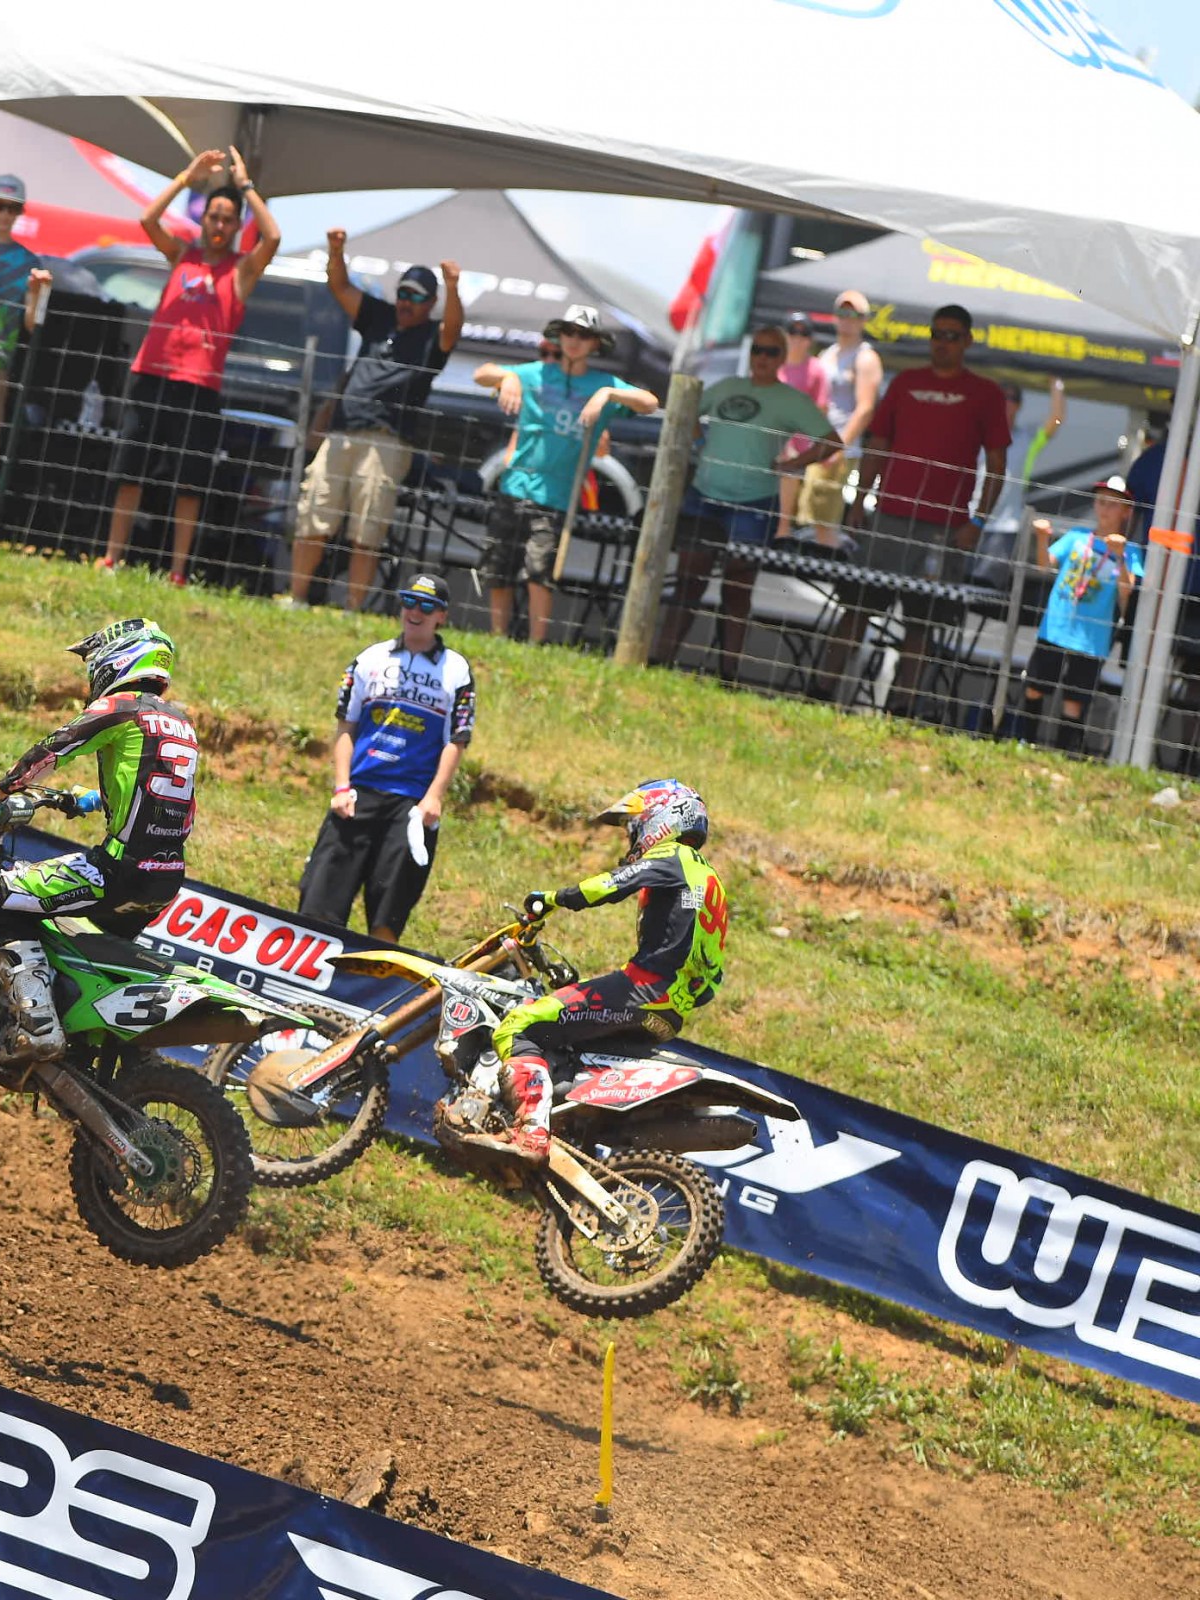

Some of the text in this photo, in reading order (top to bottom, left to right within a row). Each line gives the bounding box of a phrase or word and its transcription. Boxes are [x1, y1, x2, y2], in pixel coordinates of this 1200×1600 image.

[383, 664, 442, 691] Cycle
[368, 681, 443, 707] Trader
[141, 714, 198, 745] TOMA
[148, 742, 197, 800] 3
[644, 822, 673, 848] Bull
[255, 926, 330, 981] OIL
[114, 985, 177, 1026] 3
[601, 1008, 634, 1024] Eagle
